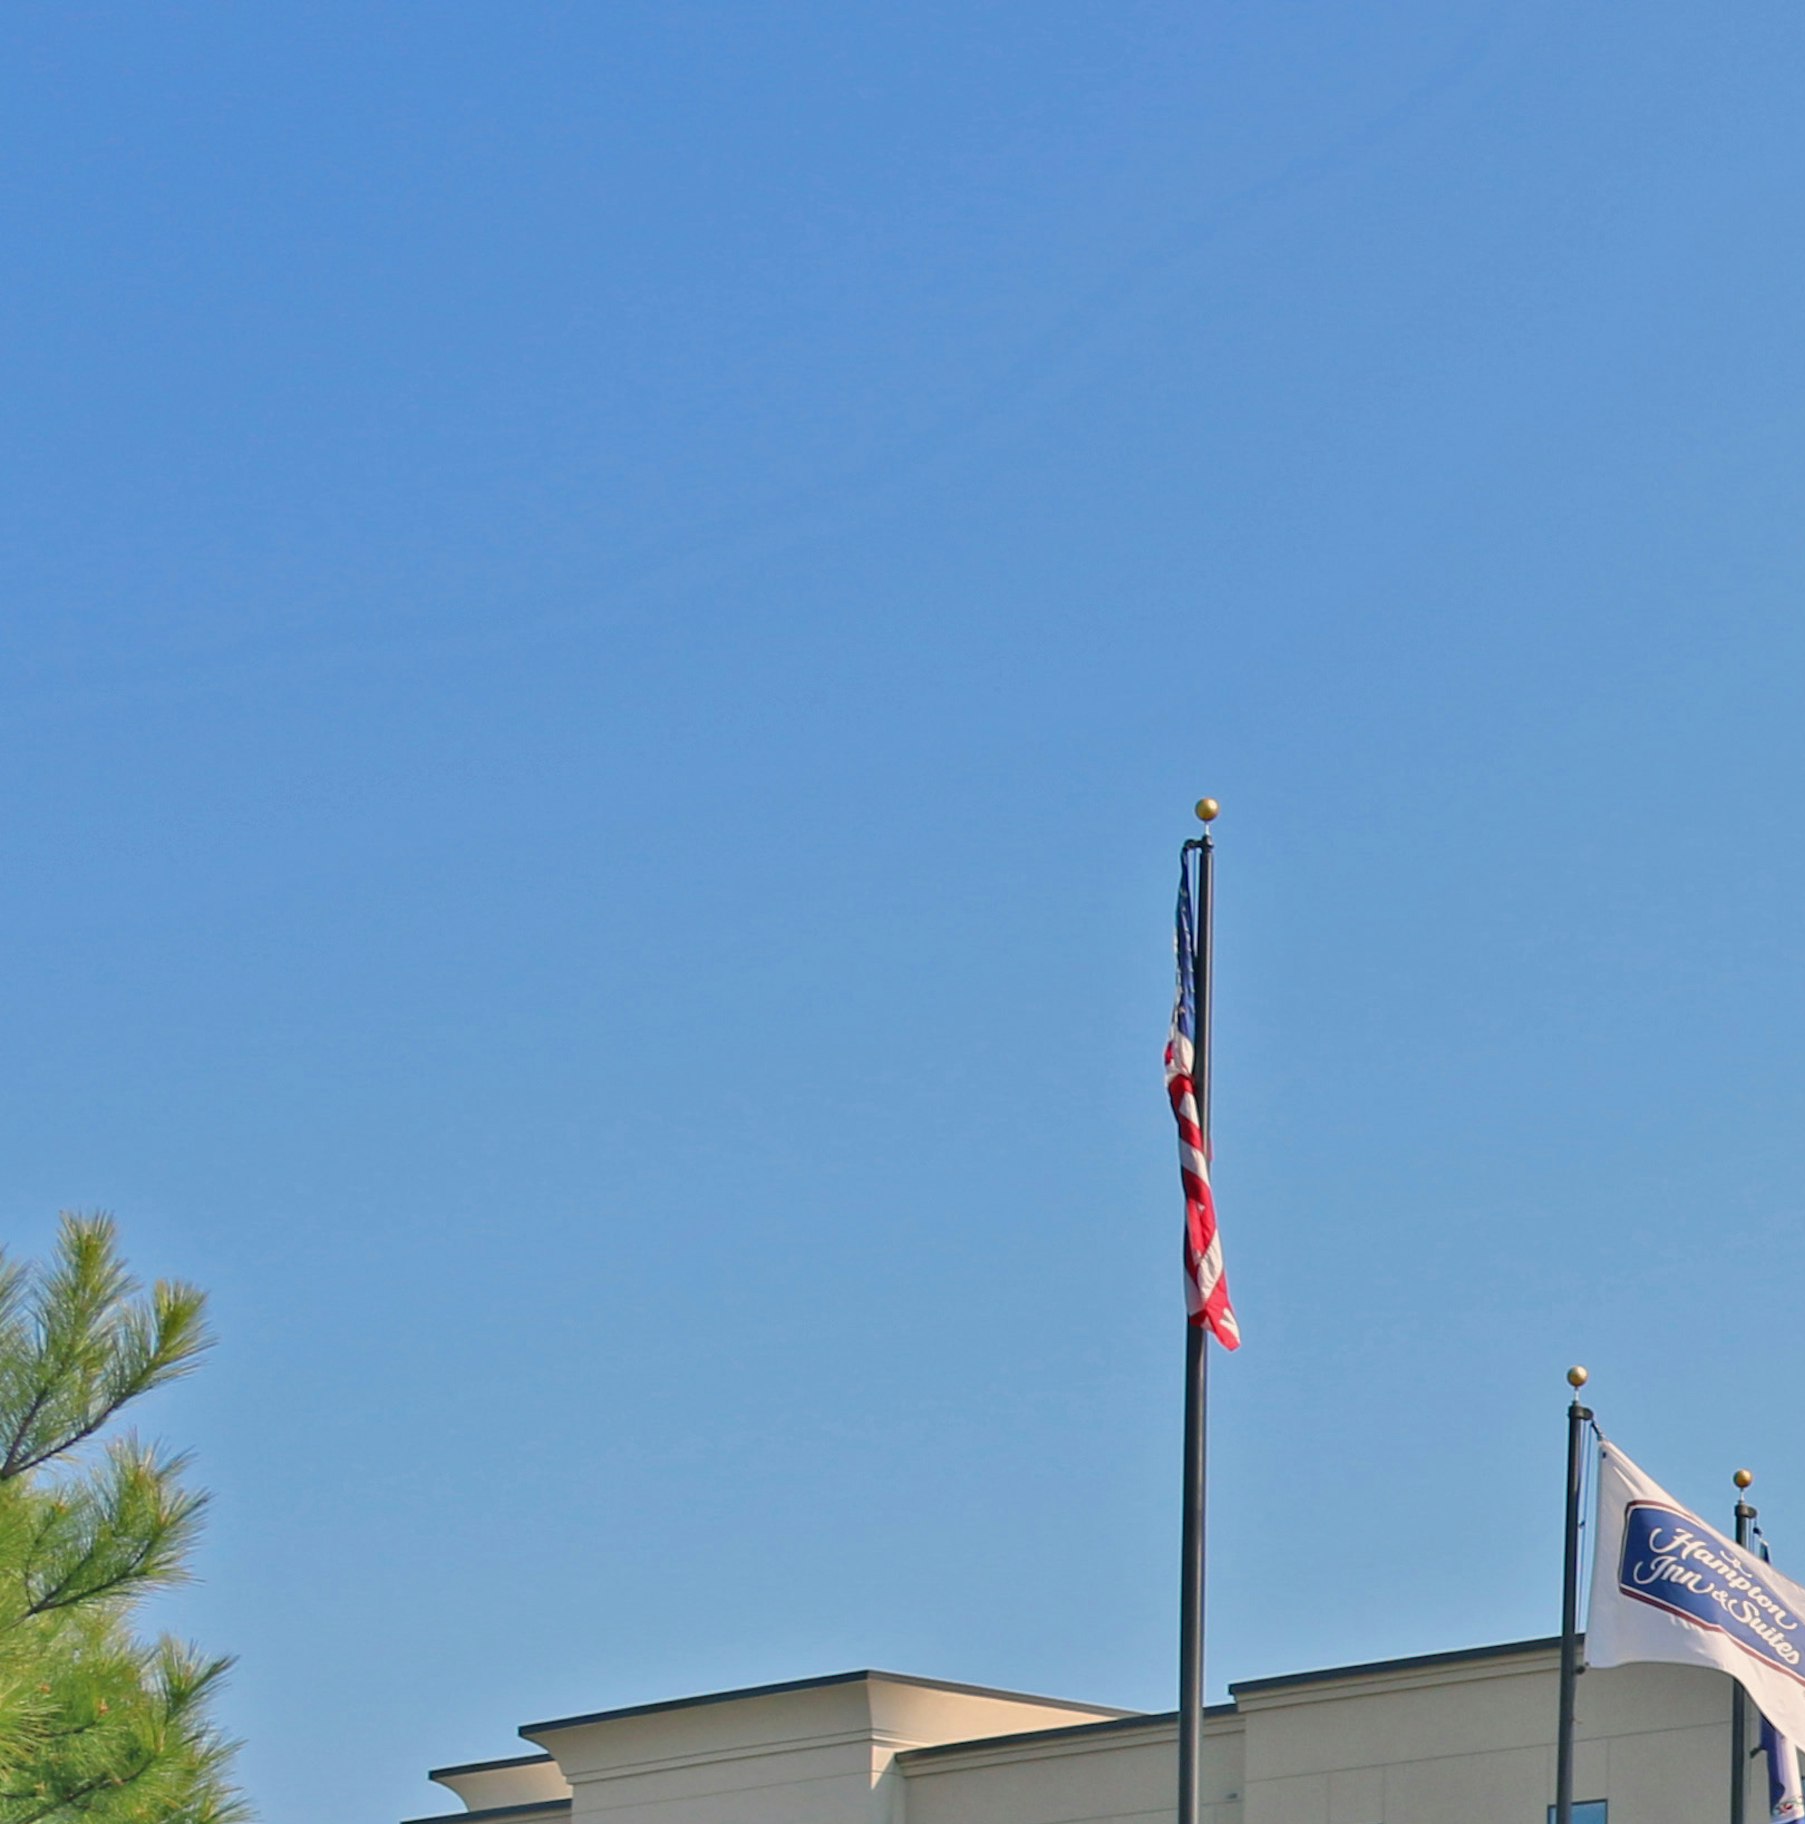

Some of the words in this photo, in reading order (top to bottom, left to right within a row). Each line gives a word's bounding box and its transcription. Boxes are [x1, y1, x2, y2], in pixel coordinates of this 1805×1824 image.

[1633, 1555, 1715, 1594] Inn
[1711, 1590, 1730, 1611] &
[1727, 1600, 1800, 1665] Suites
[1649, 1528, 1798, 1630] Hampton
